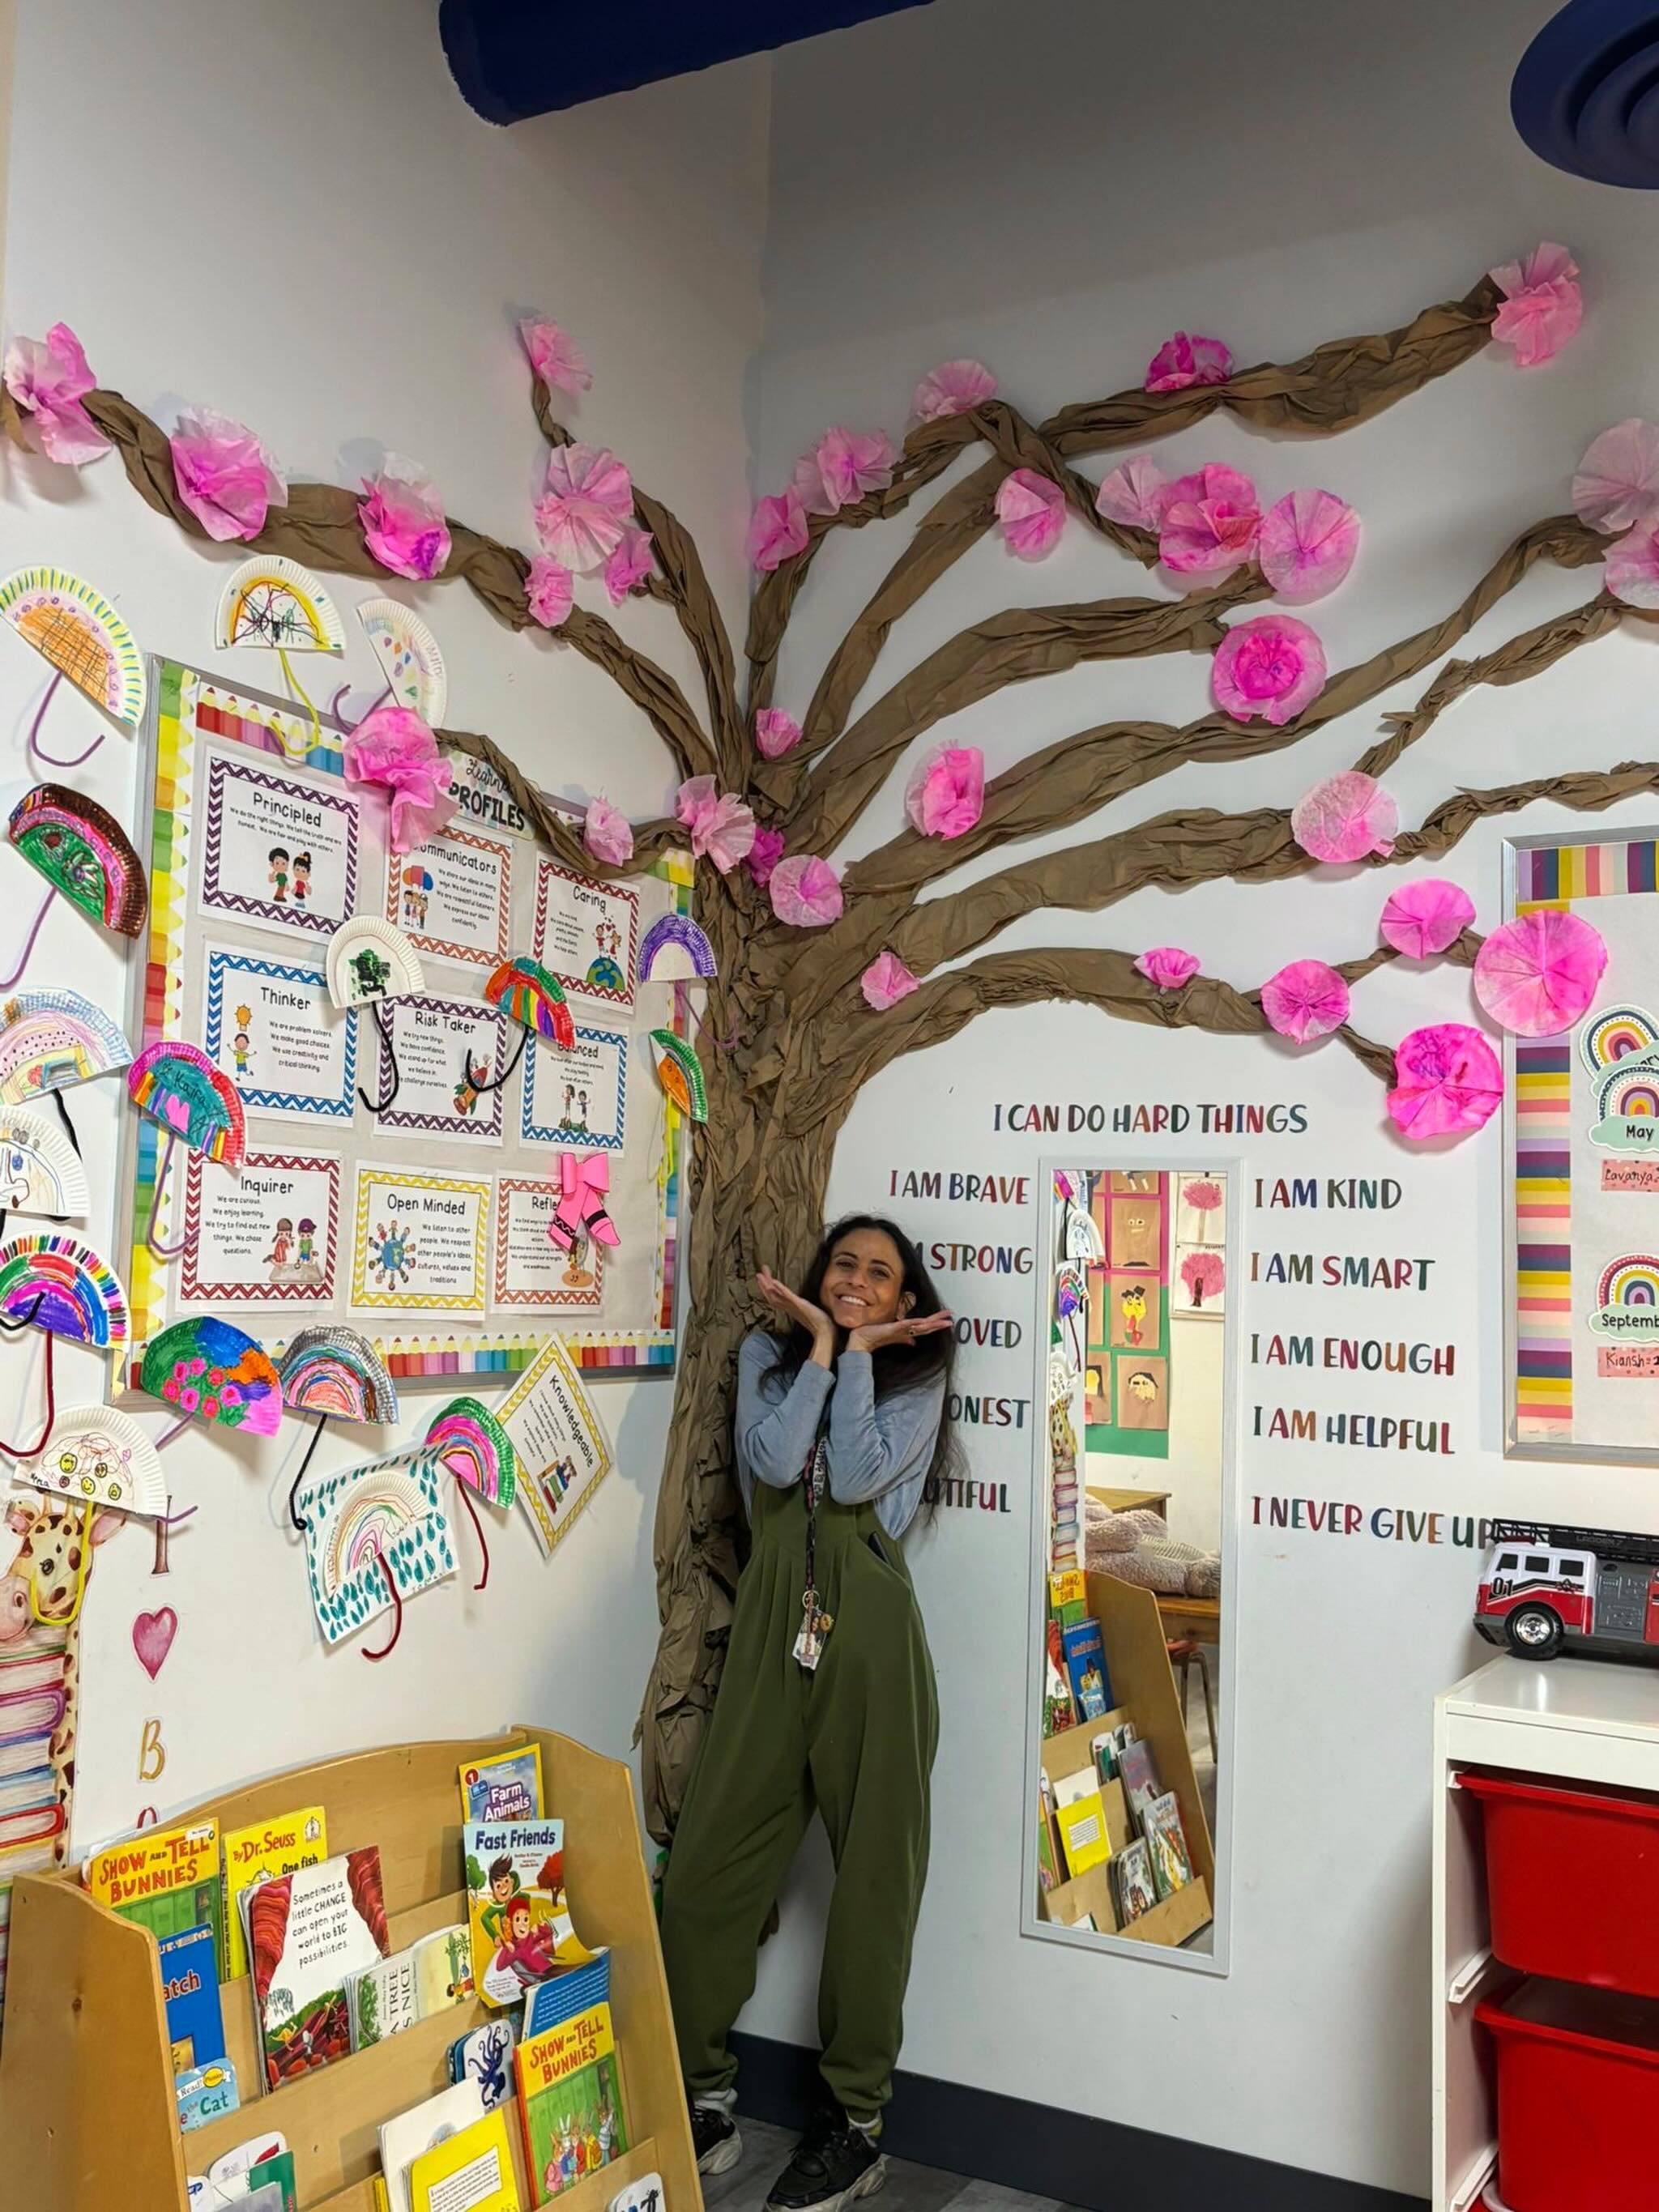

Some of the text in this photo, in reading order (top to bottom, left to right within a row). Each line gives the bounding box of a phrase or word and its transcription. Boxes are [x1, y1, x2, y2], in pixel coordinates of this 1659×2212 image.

[253, 791, 322, 828] Principled
[449, 782, 524, 831] PROFILES
[413, 843, 497, 875] ommunicators
[573, 885, 607, 913] Caring
[260, 987, 311, 1009] Thinker
[415, 1011, 476, 1034] Risk Taker
[557, 1043, 599, 1059] Bnced
[994, 1104, 1307, 1133] I CAN DO HARD THINGS
[1626, 1125, 1654, 1141] May
[241, 1176, 294, 1196] Inquirer
[890, 1170, 1030, 1204] I AM BRAVE
[1605, 1169, 1653, 1186] Lavanya
[387, 1193, 466, 1215] Open Minded
[532, 1196, 558, 1211] Refle
[1256, 1178, 1401, 1209] I AM KIND
[931, 1243, 1033, 1274] STRONG
[1252, 1252, 1435, 1291] I AM SMART
[956, 1317, 1021, 1348] OVED
[1601, 1313, 1659, 1331] Septemb
[1252, 1334, 1455, 1376] I AM ENOUGH
[549, 1375, 594, 1468] Knowledgeable
[949, 1394, 1030, 1428] ONEST
[1254, 1406, 1455, 1455] I AM HELPFUL
[919, 1477, 1011, 1512] UTIFUL
[1252, 1496, 1495, 1549] I NEVER GIVE UP
[1492, 1577, 1513, 1596] 01
[485, 1796, 530, 1822] Animals
[491, 1784, 522, 1804] Farm
[233, 1831, 296, 1863] By Dr. Seuss
[476, 1826, 556, 1851] Fast Friends
[100, 1850, 147, 1886] SHOW
[164, 1835, 211, 1864] TELL
[282, 1853, 318, 1874] One fish
[110, 1859, 198, 1903] BUNNIES
[292, 1883, 335, 1905] Sometimes
[292, 1892, 346, 1922] little CHANGE
[292, 1908, 348, 1937] can open your
[298, 1923, 348, 1949] world to BIG
[164, 1969, 200, 2002] atch
[390, 1969, 399, 2021] TREE
[401, 1963, 412, 2011] NICE
[530, 2035, 565, 2069] SHOW
[574, 2016, 603, 2045] TELL
[542, 2039, 597, 2084] BUNNIES
[200, 2091, 229, 2116] Cat
